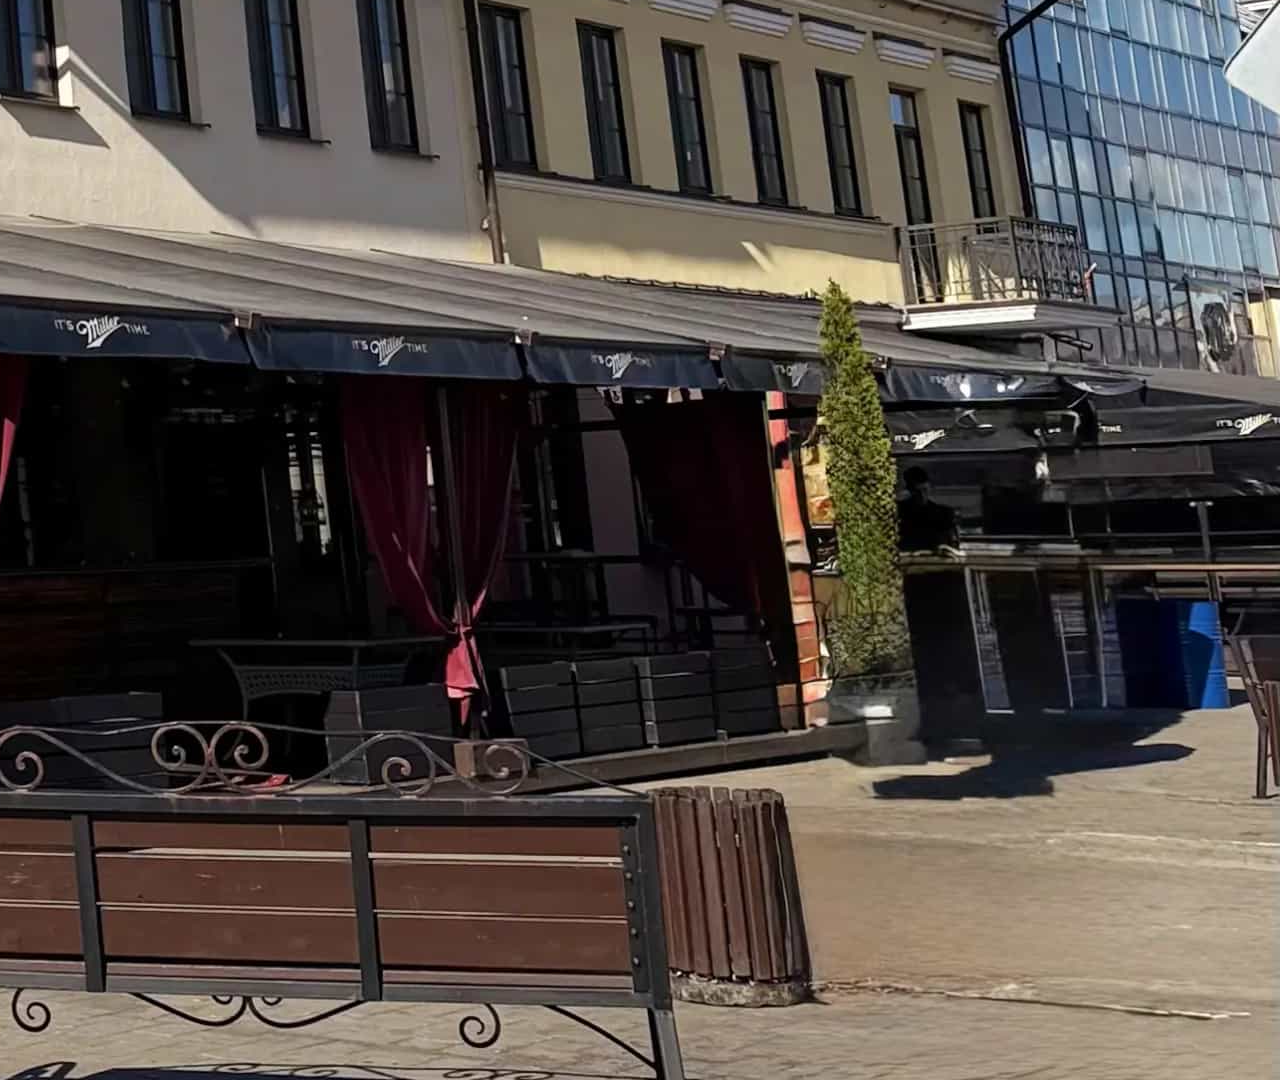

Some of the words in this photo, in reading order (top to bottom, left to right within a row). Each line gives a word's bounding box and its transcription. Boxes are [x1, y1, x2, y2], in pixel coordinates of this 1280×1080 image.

[76, 315, 130, 349] Miller
[127, 324, 151, 335] TIME
[370, 336, 406, 367] Miller
